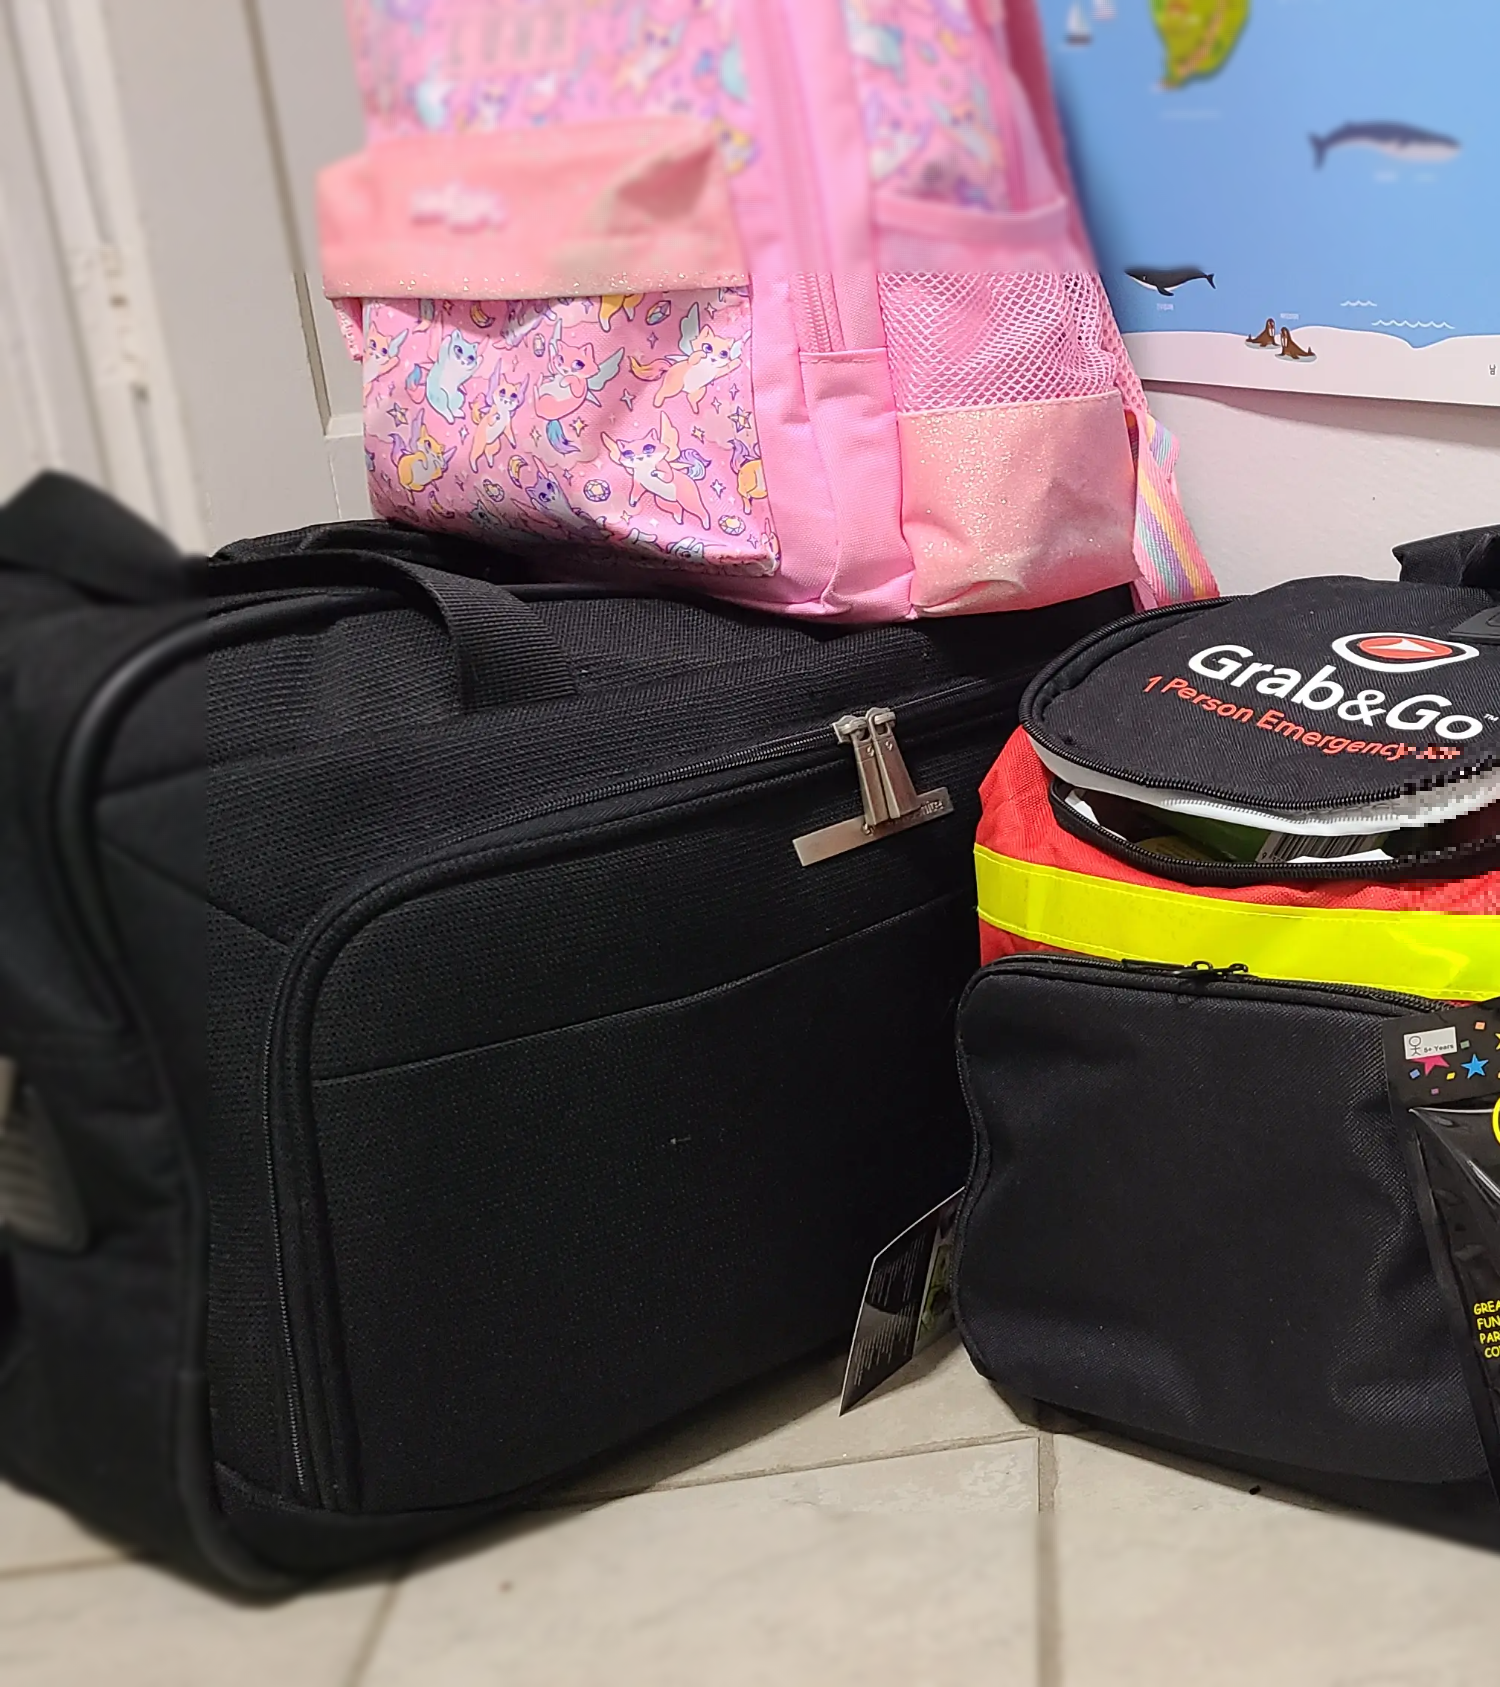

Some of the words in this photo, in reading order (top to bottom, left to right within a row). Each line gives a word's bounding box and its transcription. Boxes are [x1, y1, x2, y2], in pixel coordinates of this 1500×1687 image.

[1142, 675, 1163, 693] 1
[1160, 675, 1255, 723] Person
[1255, 708, 1416, 761] Emergency
